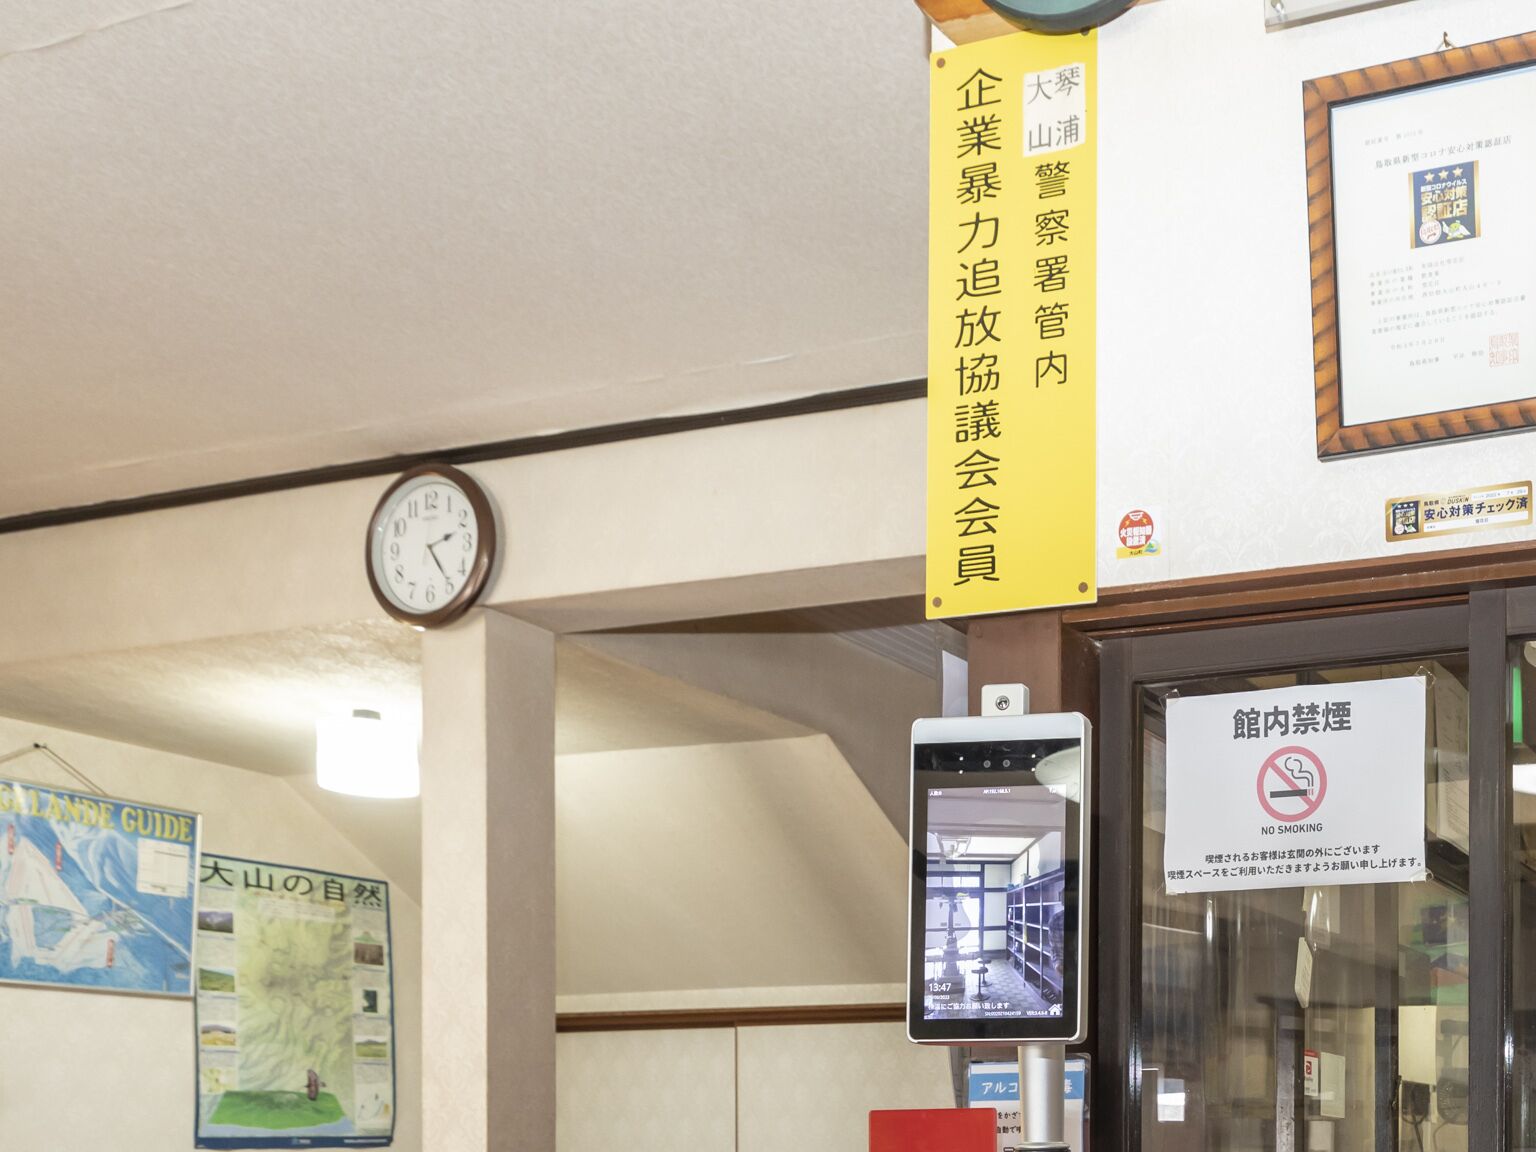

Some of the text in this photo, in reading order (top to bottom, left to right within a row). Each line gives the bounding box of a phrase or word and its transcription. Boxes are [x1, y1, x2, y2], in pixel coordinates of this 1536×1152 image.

[1033, 160, 1070, 389] 警察署管内
[954, 67, 1002, 588] 企業暴力追放協議会会員
[407, 500, 419, 518] 11
[424, 490, 439, 511] 12
[1424, 497, 1528, 521] 安心対策チェック済
[394, 518, 407, 537] 10
[458, 509, 468, 528] 2
[390, 543, 400, 561] 9
[462, 533, 472, 552] 3
[395, 564, 405, 584] 8
[457, 557, 466, 577] 4
[408, 581, 416, 600] 7
[425, 585, 436, 603] 6
[1232, 701, 1352, 740] 館内禁煙
[121, 806, 193, 842] GUIDE
[1261, 823, 1323, 836] NO SMOKING
[1204, 844, 1381, 865] 喫煙されるお客様は玄関の外にございます
[1167, 856, 1422, 881] 喫煙スペースをご利用いただきますようお願い申し上げます。
[200, 860, 383, 908] 大山の自然
[928, 982, 952, 992] 13:47
